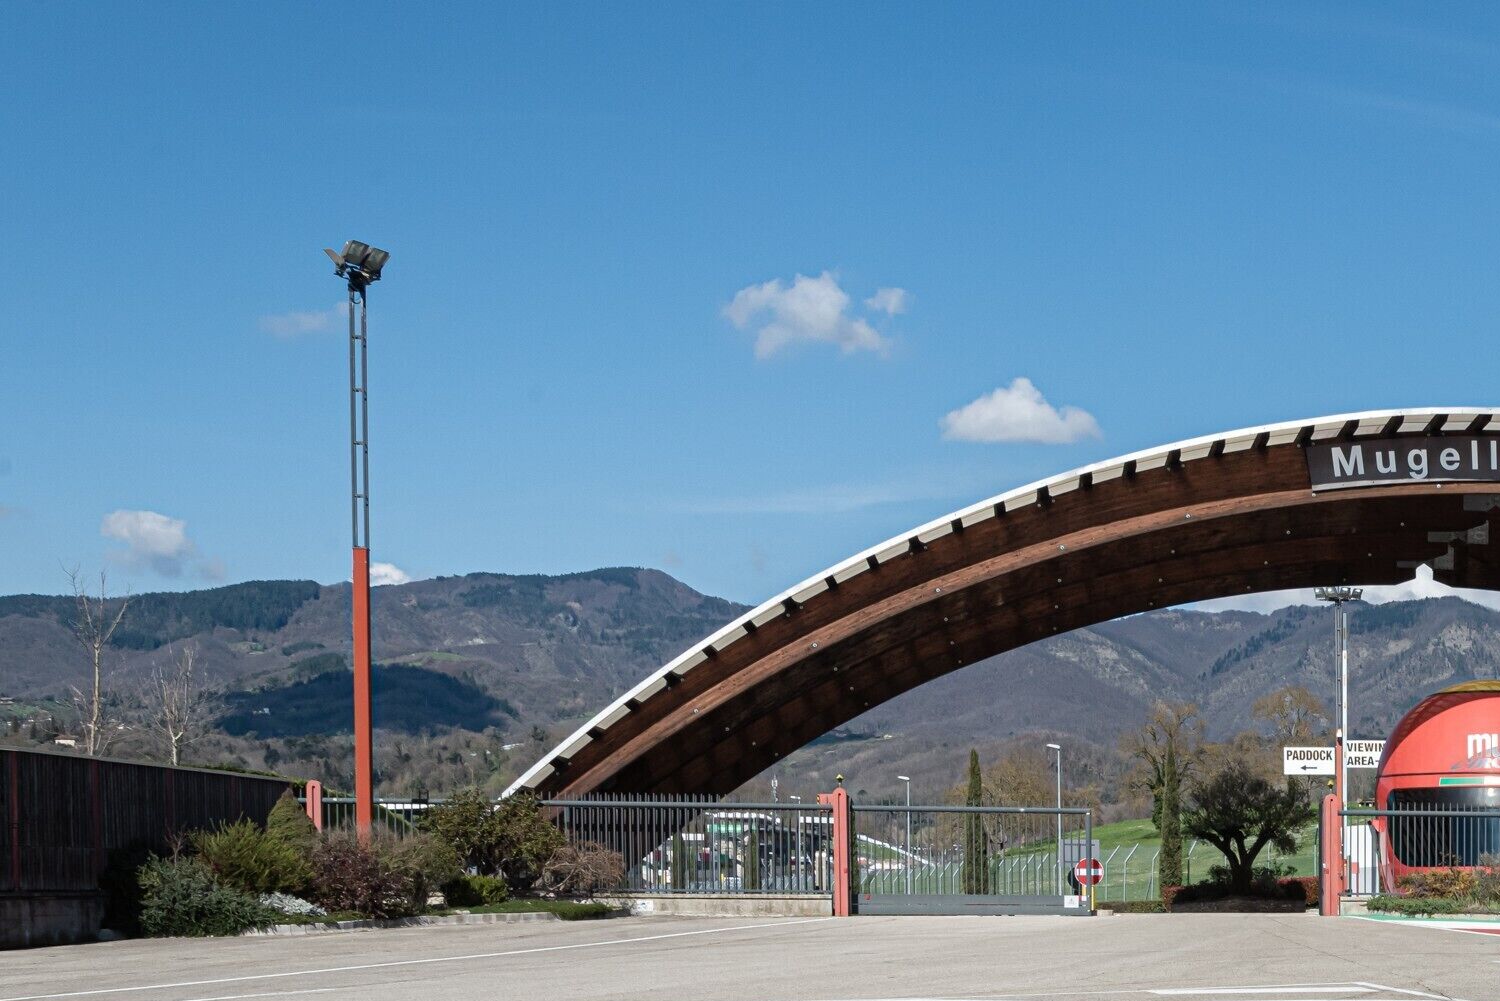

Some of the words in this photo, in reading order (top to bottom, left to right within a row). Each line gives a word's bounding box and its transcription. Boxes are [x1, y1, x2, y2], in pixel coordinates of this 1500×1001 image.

[1346, 742, 1385, 752] VIEWIN
[1286, 750, 1333, 761] PADDOCK
[1346, 756, 1375, 766] AREA
